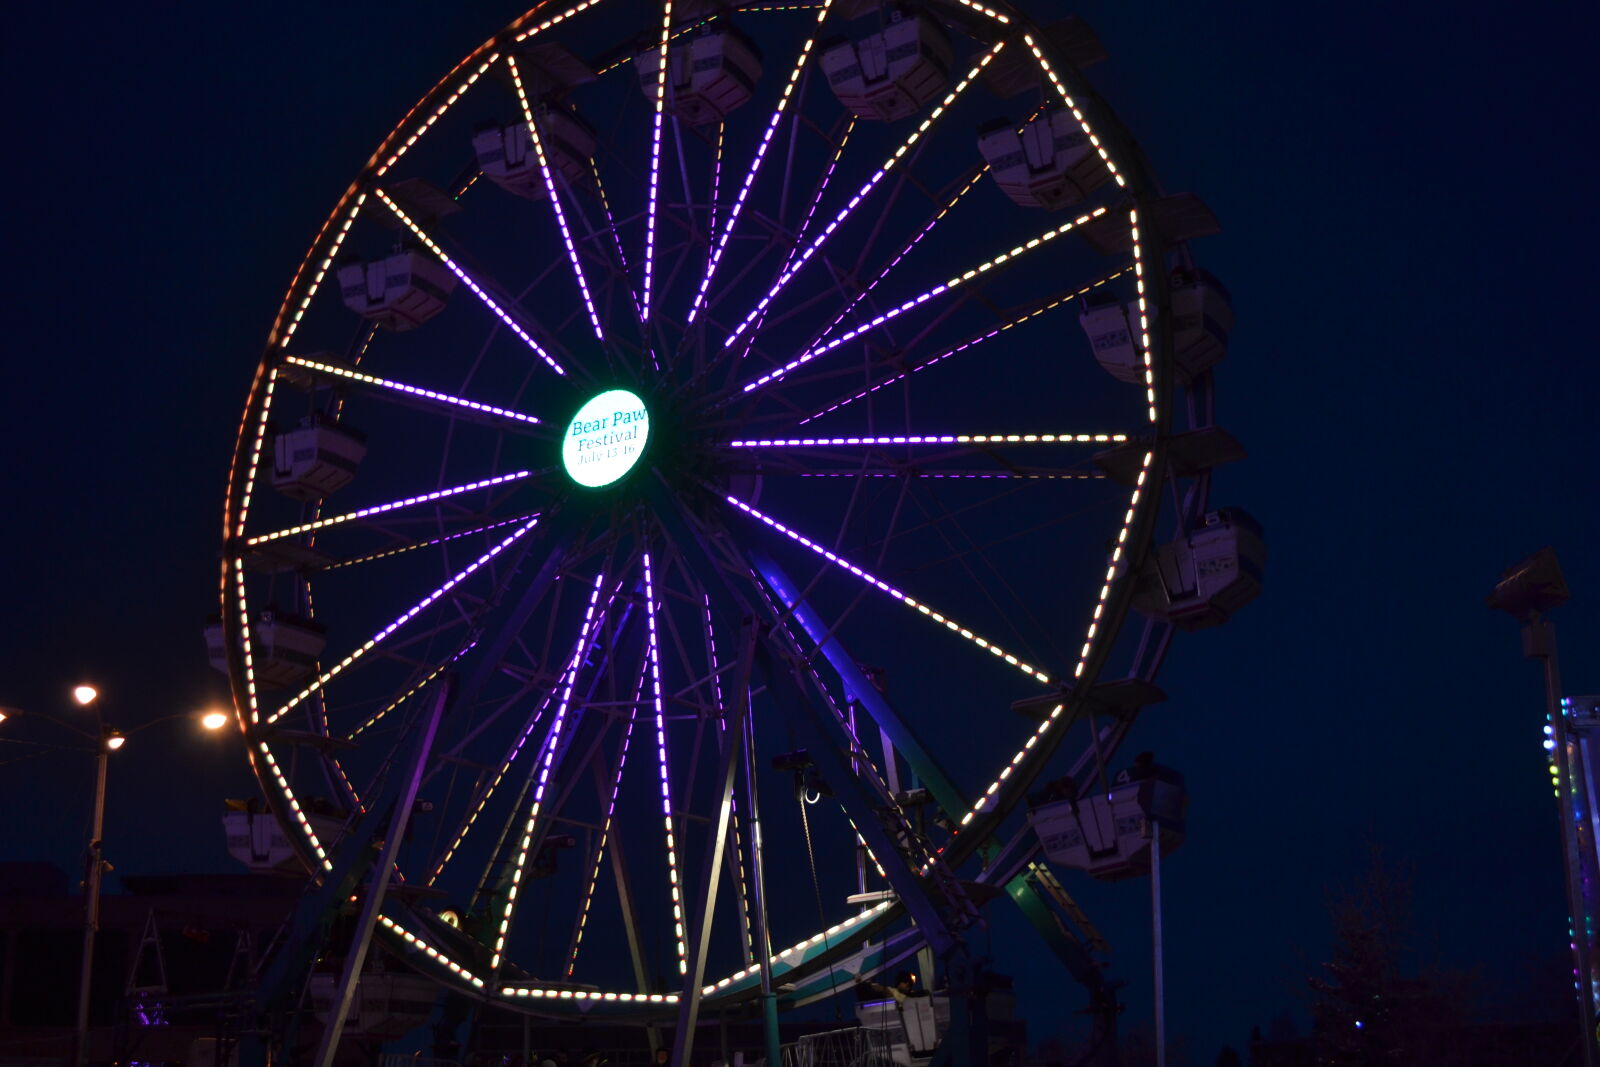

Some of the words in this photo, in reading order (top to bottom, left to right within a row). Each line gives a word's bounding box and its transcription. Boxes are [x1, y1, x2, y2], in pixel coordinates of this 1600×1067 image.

[572, 417, 610, 436] Bear
[613, 408, 646, 427] Paw
[578, 425, 637, 452] Festival
[578, 451, 603, 465] July
[1205, 511, 1220, 525] 5
[1117, 769, 1130, 784] 4
